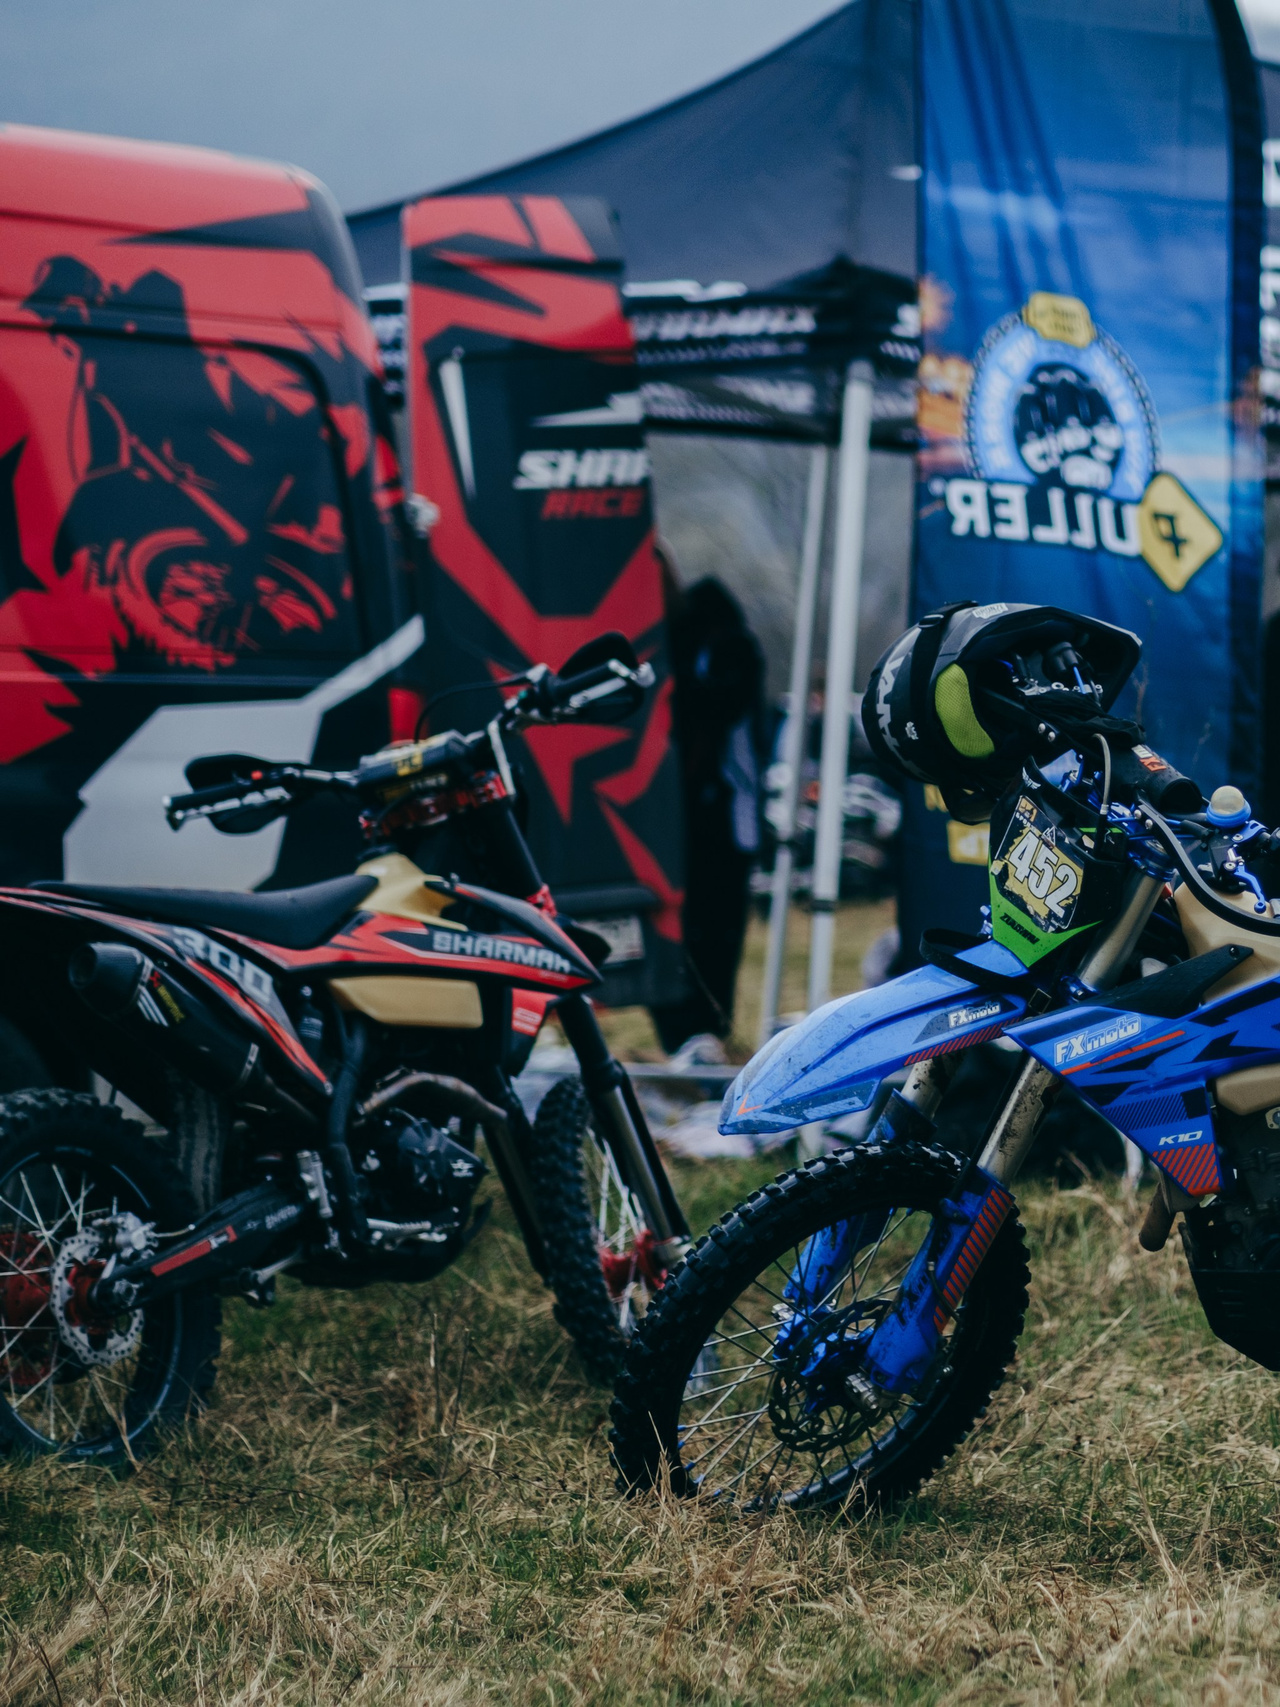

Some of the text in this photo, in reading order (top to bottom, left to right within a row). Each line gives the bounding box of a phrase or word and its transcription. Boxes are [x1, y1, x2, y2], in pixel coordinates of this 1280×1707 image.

[1008, 829, 1079, 919] 452
[948, 1001, 1001, 1029] FXmoto
[1054, 1015, 1141, 1066] FXmoto
[1158, 1130, 1203, 1146] K10
